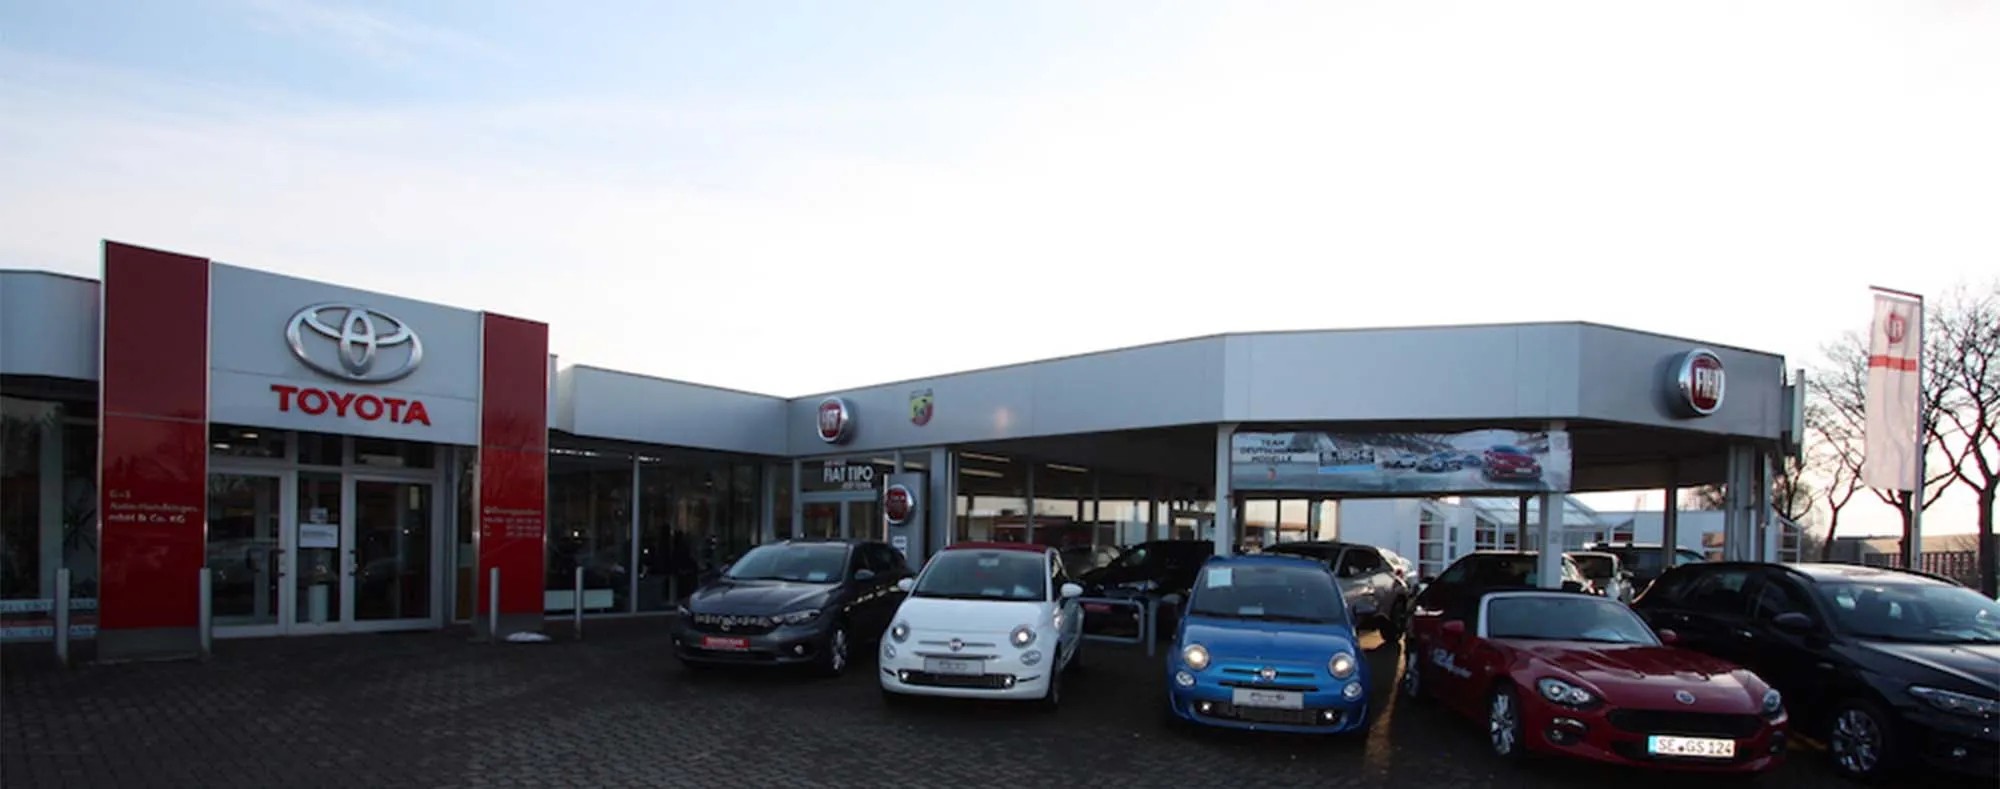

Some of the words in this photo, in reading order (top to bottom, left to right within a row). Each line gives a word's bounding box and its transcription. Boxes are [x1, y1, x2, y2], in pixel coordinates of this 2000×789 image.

[270, 384, 431, 426] TOYOTA
[824, 466, 846, 482] FIAT
[848, 466, 874, 481] TIPO
[1658, 738, 1676, 753] SE
[1686, 740, 1705, 754] GS
[1709, 742, 1731, 755] 124
